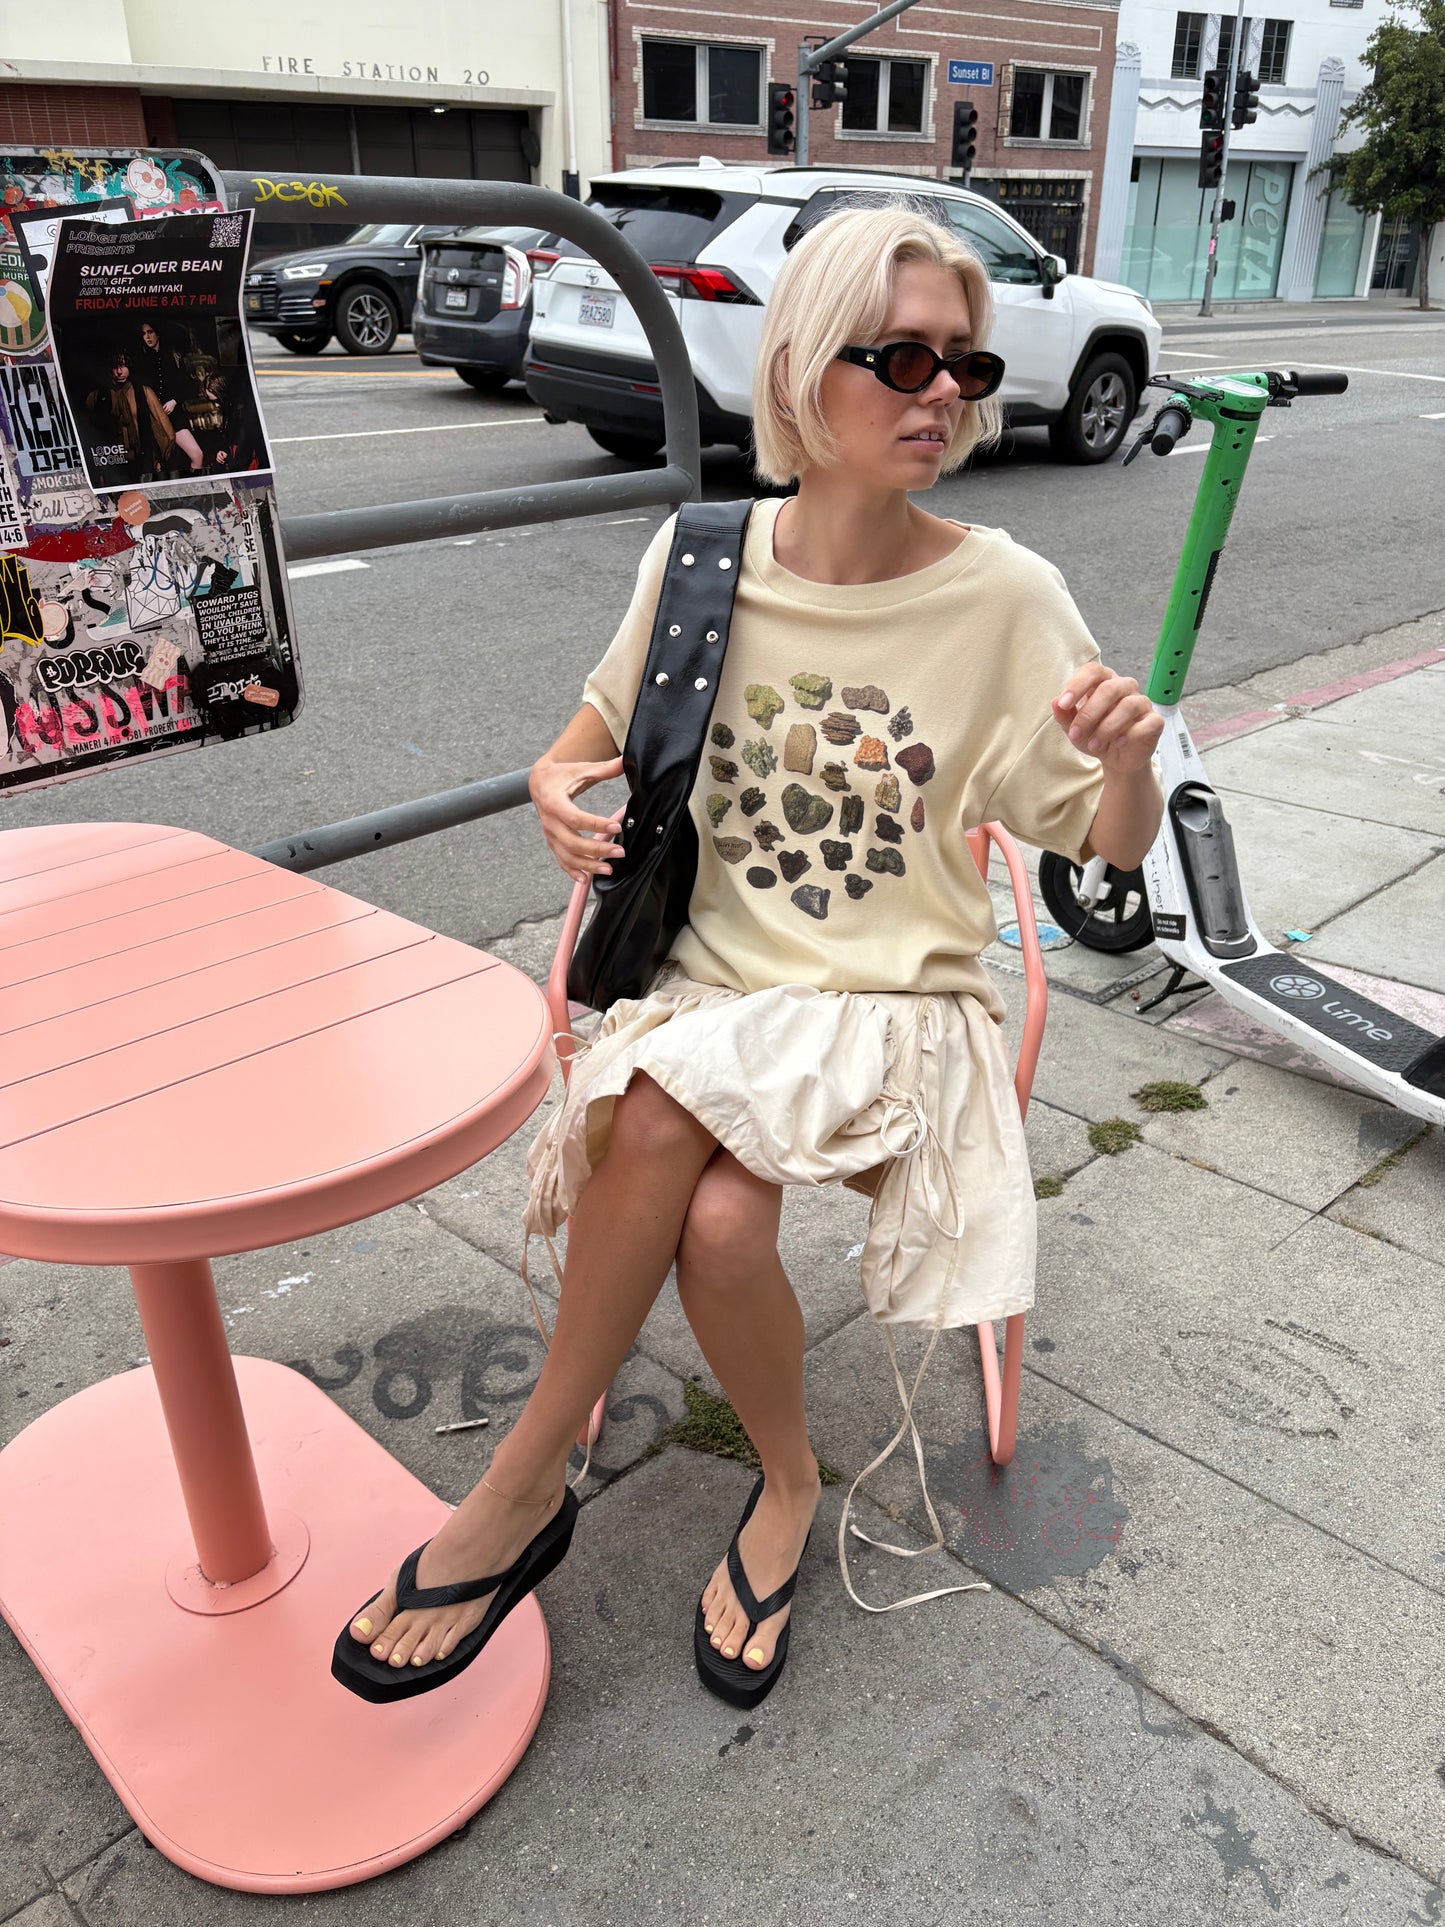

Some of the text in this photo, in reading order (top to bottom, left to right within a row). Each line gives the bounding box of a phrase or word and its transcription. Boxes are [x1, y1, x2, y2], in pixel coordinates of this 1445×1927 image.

[262, 55, 490, 86] FIRE STATION 20
[952, 65, 991, 81] Sunset Bl
[69, 230, 157, 244] LODGE ROOM
[65, 243, 136, 257] PRESENTS
[80, 259, 223, 277] SUNFLOWER BEAN
[79, 284, 184, 297] AND TASHAKI MIYAKI
[81, 277, 134, 286] WITH GIFT
[75, 294, 217, 311] FRIDAY JUNE 6 AT 7 PM
[196, 590, 259, 609] COWARD PIGS
[199, 599, 259, 616] WOULDN'T SAVE
[200, 606, 261, 624] SCHOOL CHILDREN
[201, 622, 212, 631] IN
[250, 612, 262, 621] TX
[202, 620, 263, 640] DO YOU THINK
[203, 635, 230, 646] THEY'LL
[230, 631, 247, 640] SAVE
[248, 627, 265, 636] YOU?
[220, 652, 246, 662] FUCKING
[246, 647, 267, 656] POLICE
[72, 739, 102, 755] MANERI
[144, 721, 179, 737] PROPERTY
[181, 715, 198, 728] CITY
[1322, 1001, 1393, 1041] Lime
